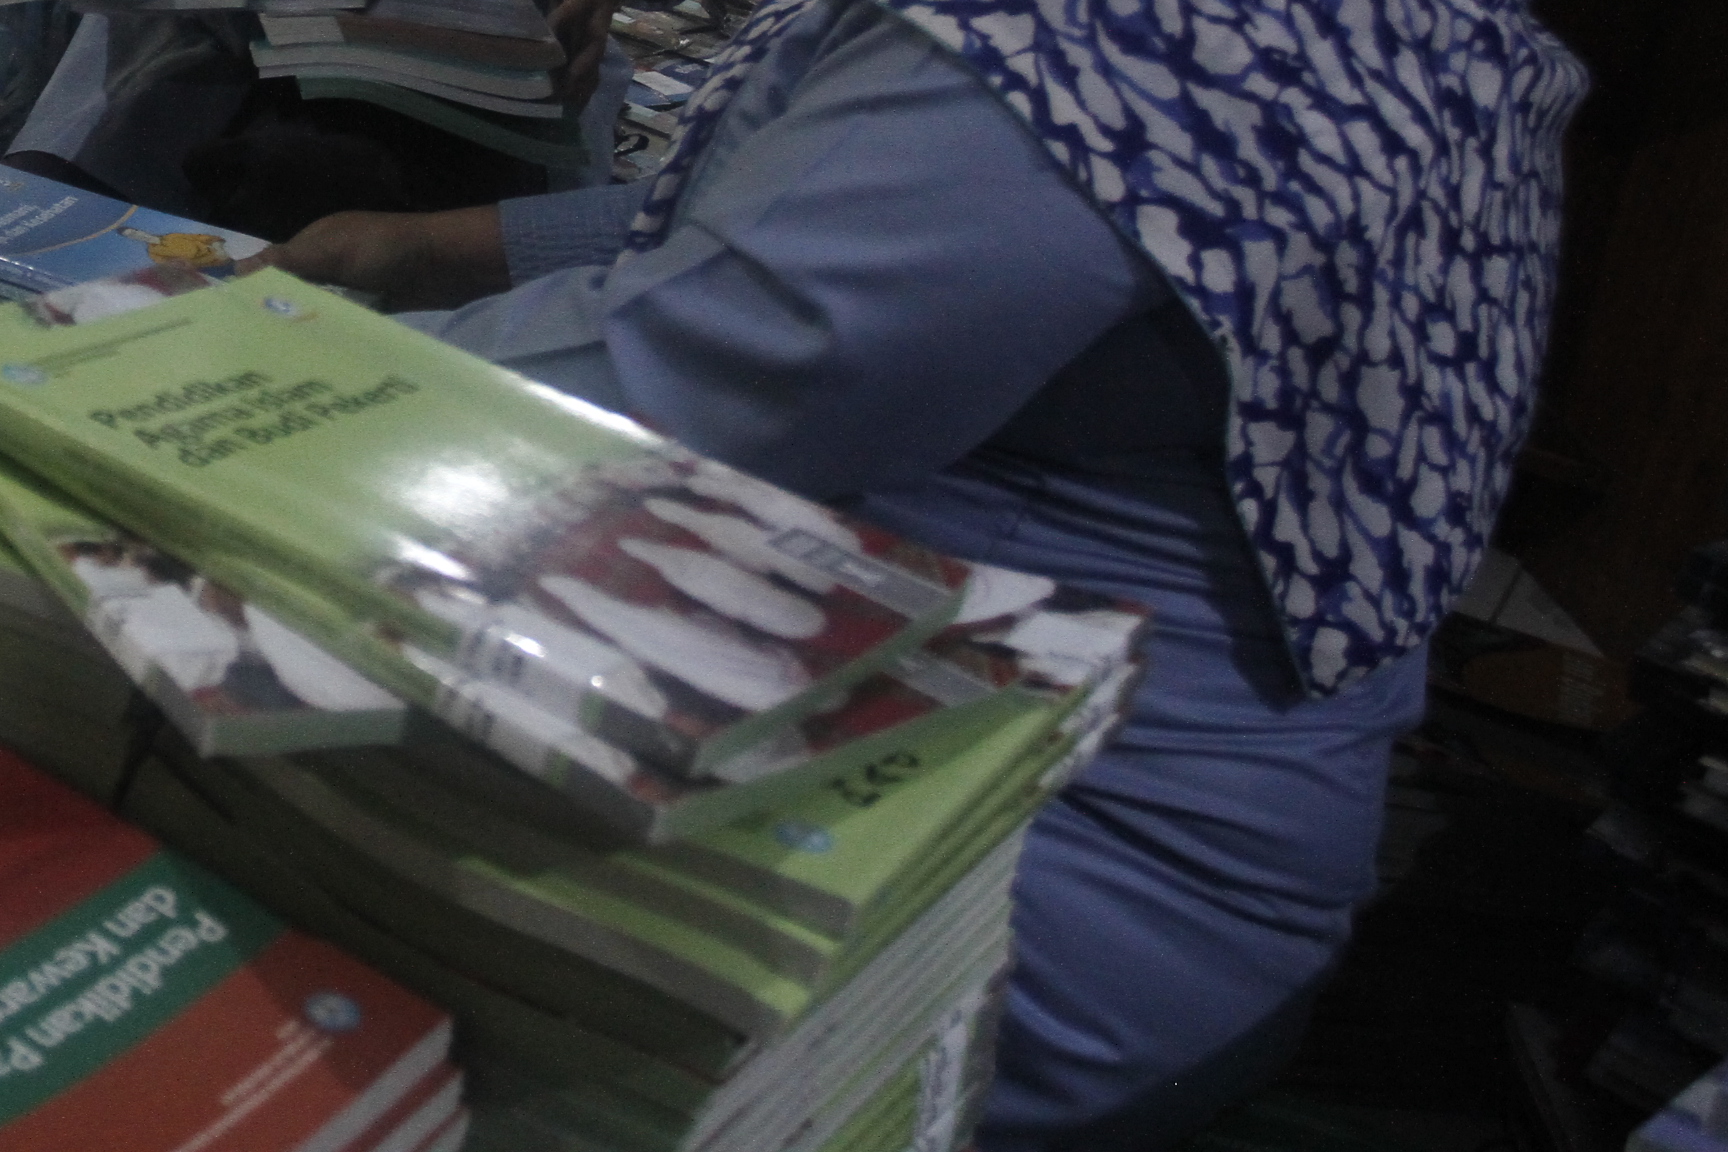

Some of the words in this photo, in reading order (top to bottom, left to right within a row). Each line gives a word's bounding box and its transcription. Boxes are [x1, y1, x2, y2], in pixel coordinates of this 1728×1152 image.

[88, 369, 272, 429] Pendidikan
[133, 405, 255, 448] Agama
[242, 378, 332, 411] Islam
[177, 437, 246, 468] dan
[232, 408, 320, 444] Budi
[305, 374, 420, 420] Pekerti
[102, 886, 177, 938] dan
[25, 909, 229, 1048] Pendidikan
